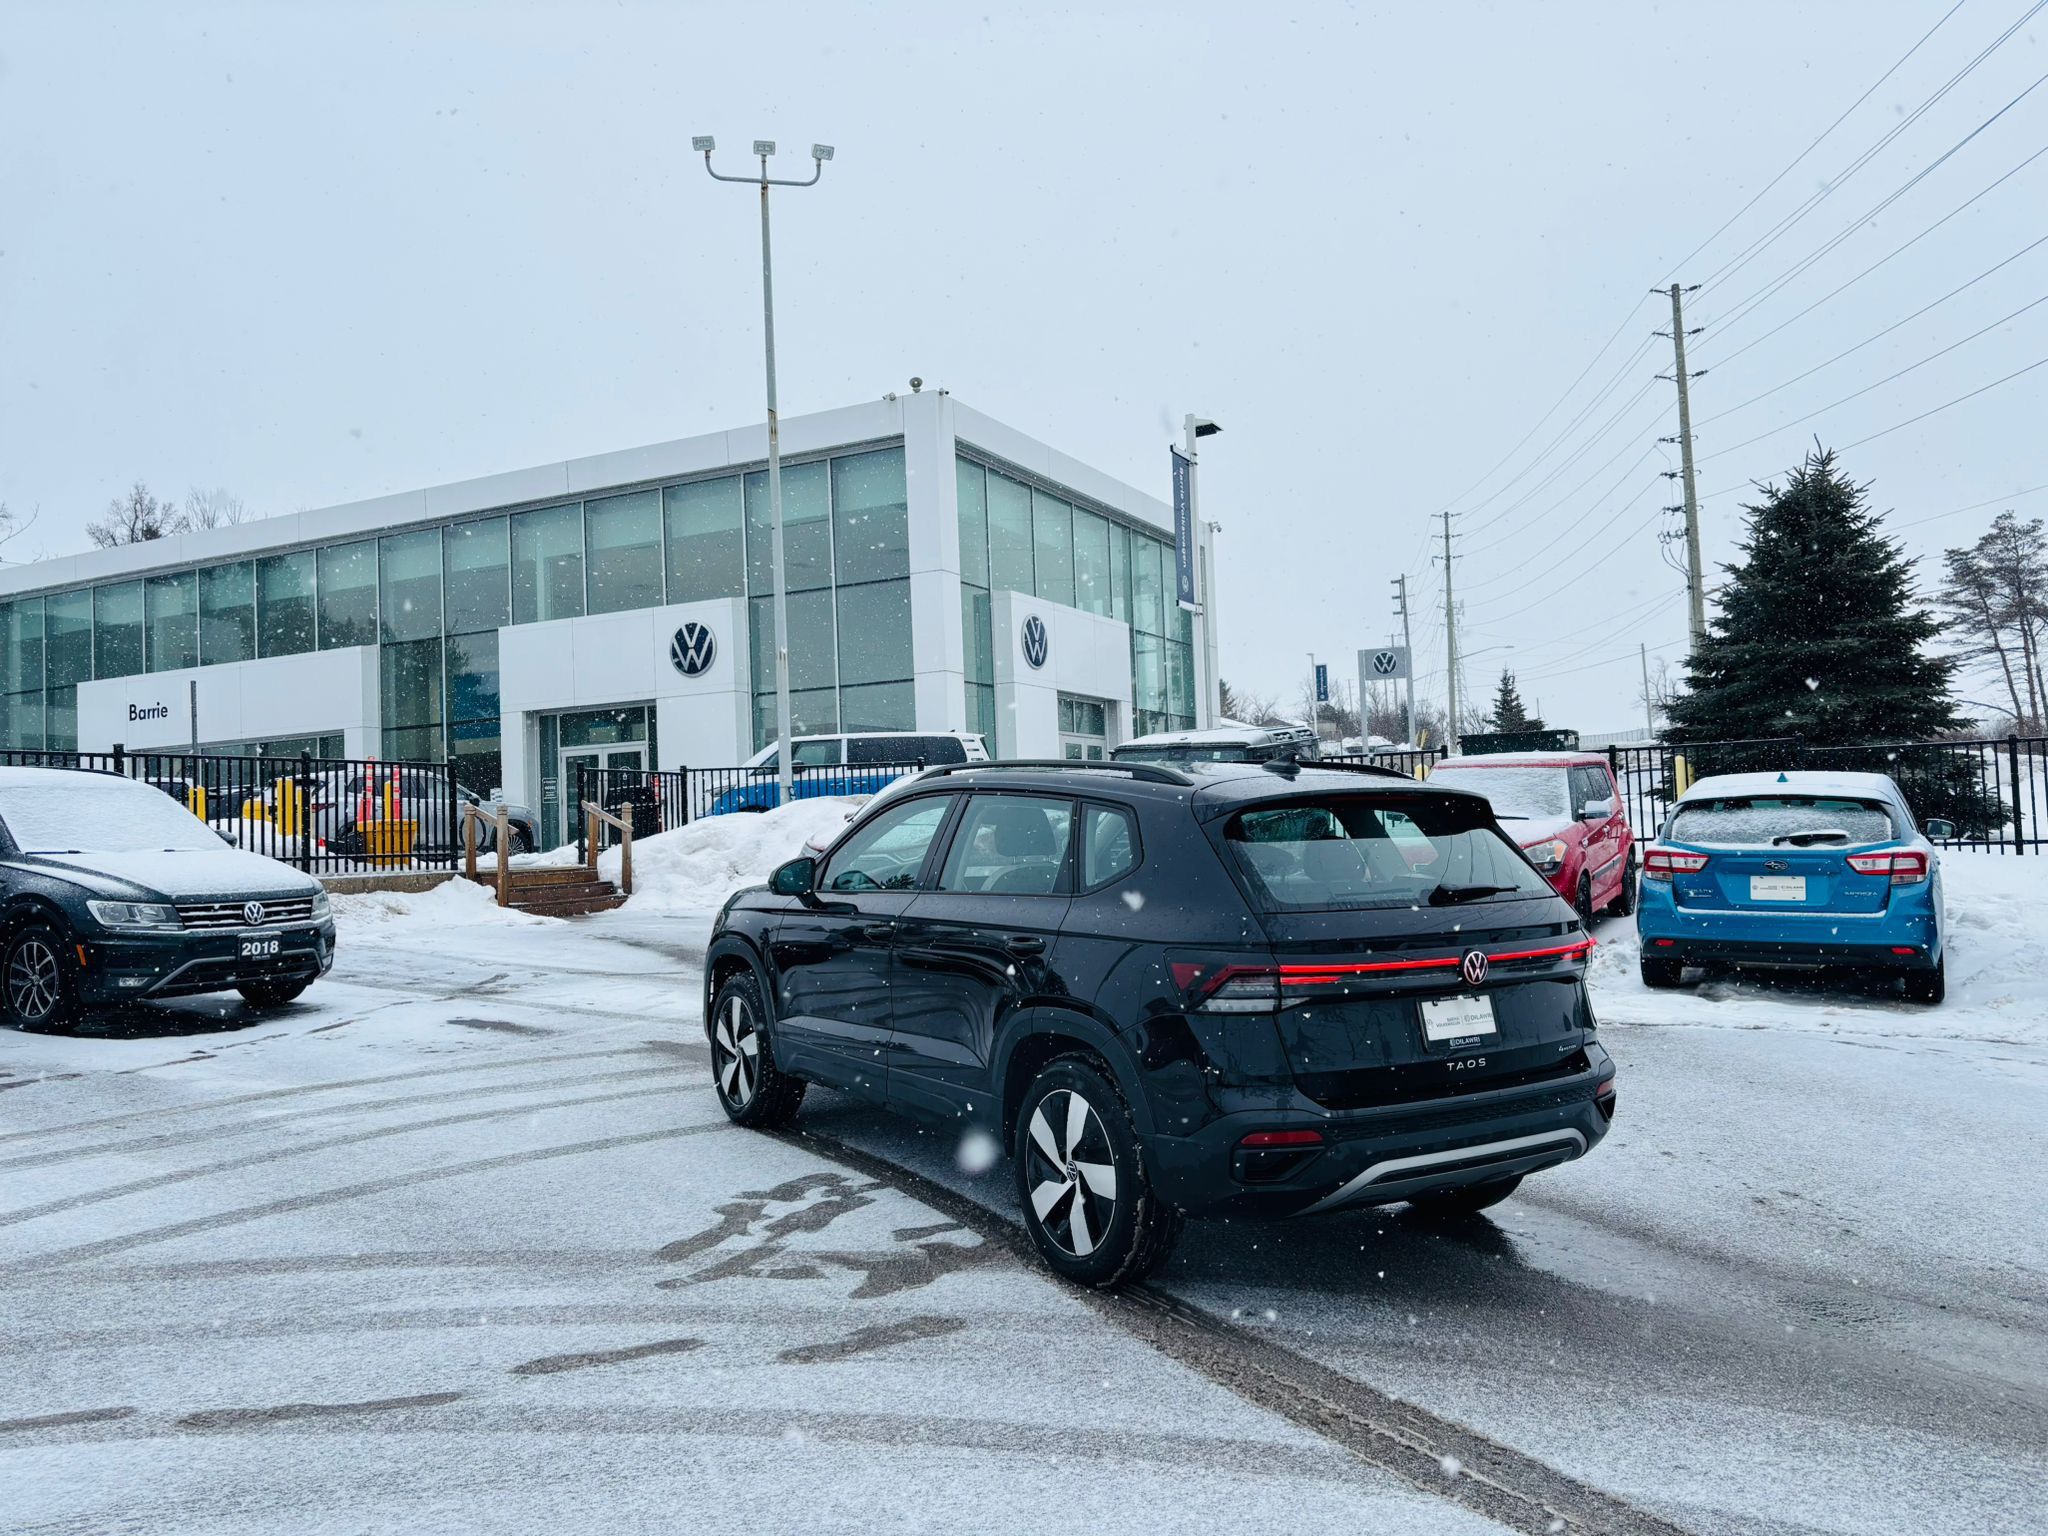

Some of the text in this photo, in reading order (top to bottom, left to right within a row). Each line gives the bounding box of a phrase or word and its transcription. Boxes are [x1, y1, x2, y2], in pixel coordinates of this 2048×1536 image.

[671, 621, 715, 676] VW
[1022, 615, 1048, 668] VW
[1373, 651, 1397, 675] VW
[129, 701, 168, 721] Barrie
[244, 901, 265, 925] VW
[241, 940, 279, 956] 2018
[1463, 951, 1489, 985] VW
[1446, 1057, 1487, 1072] TAOS
